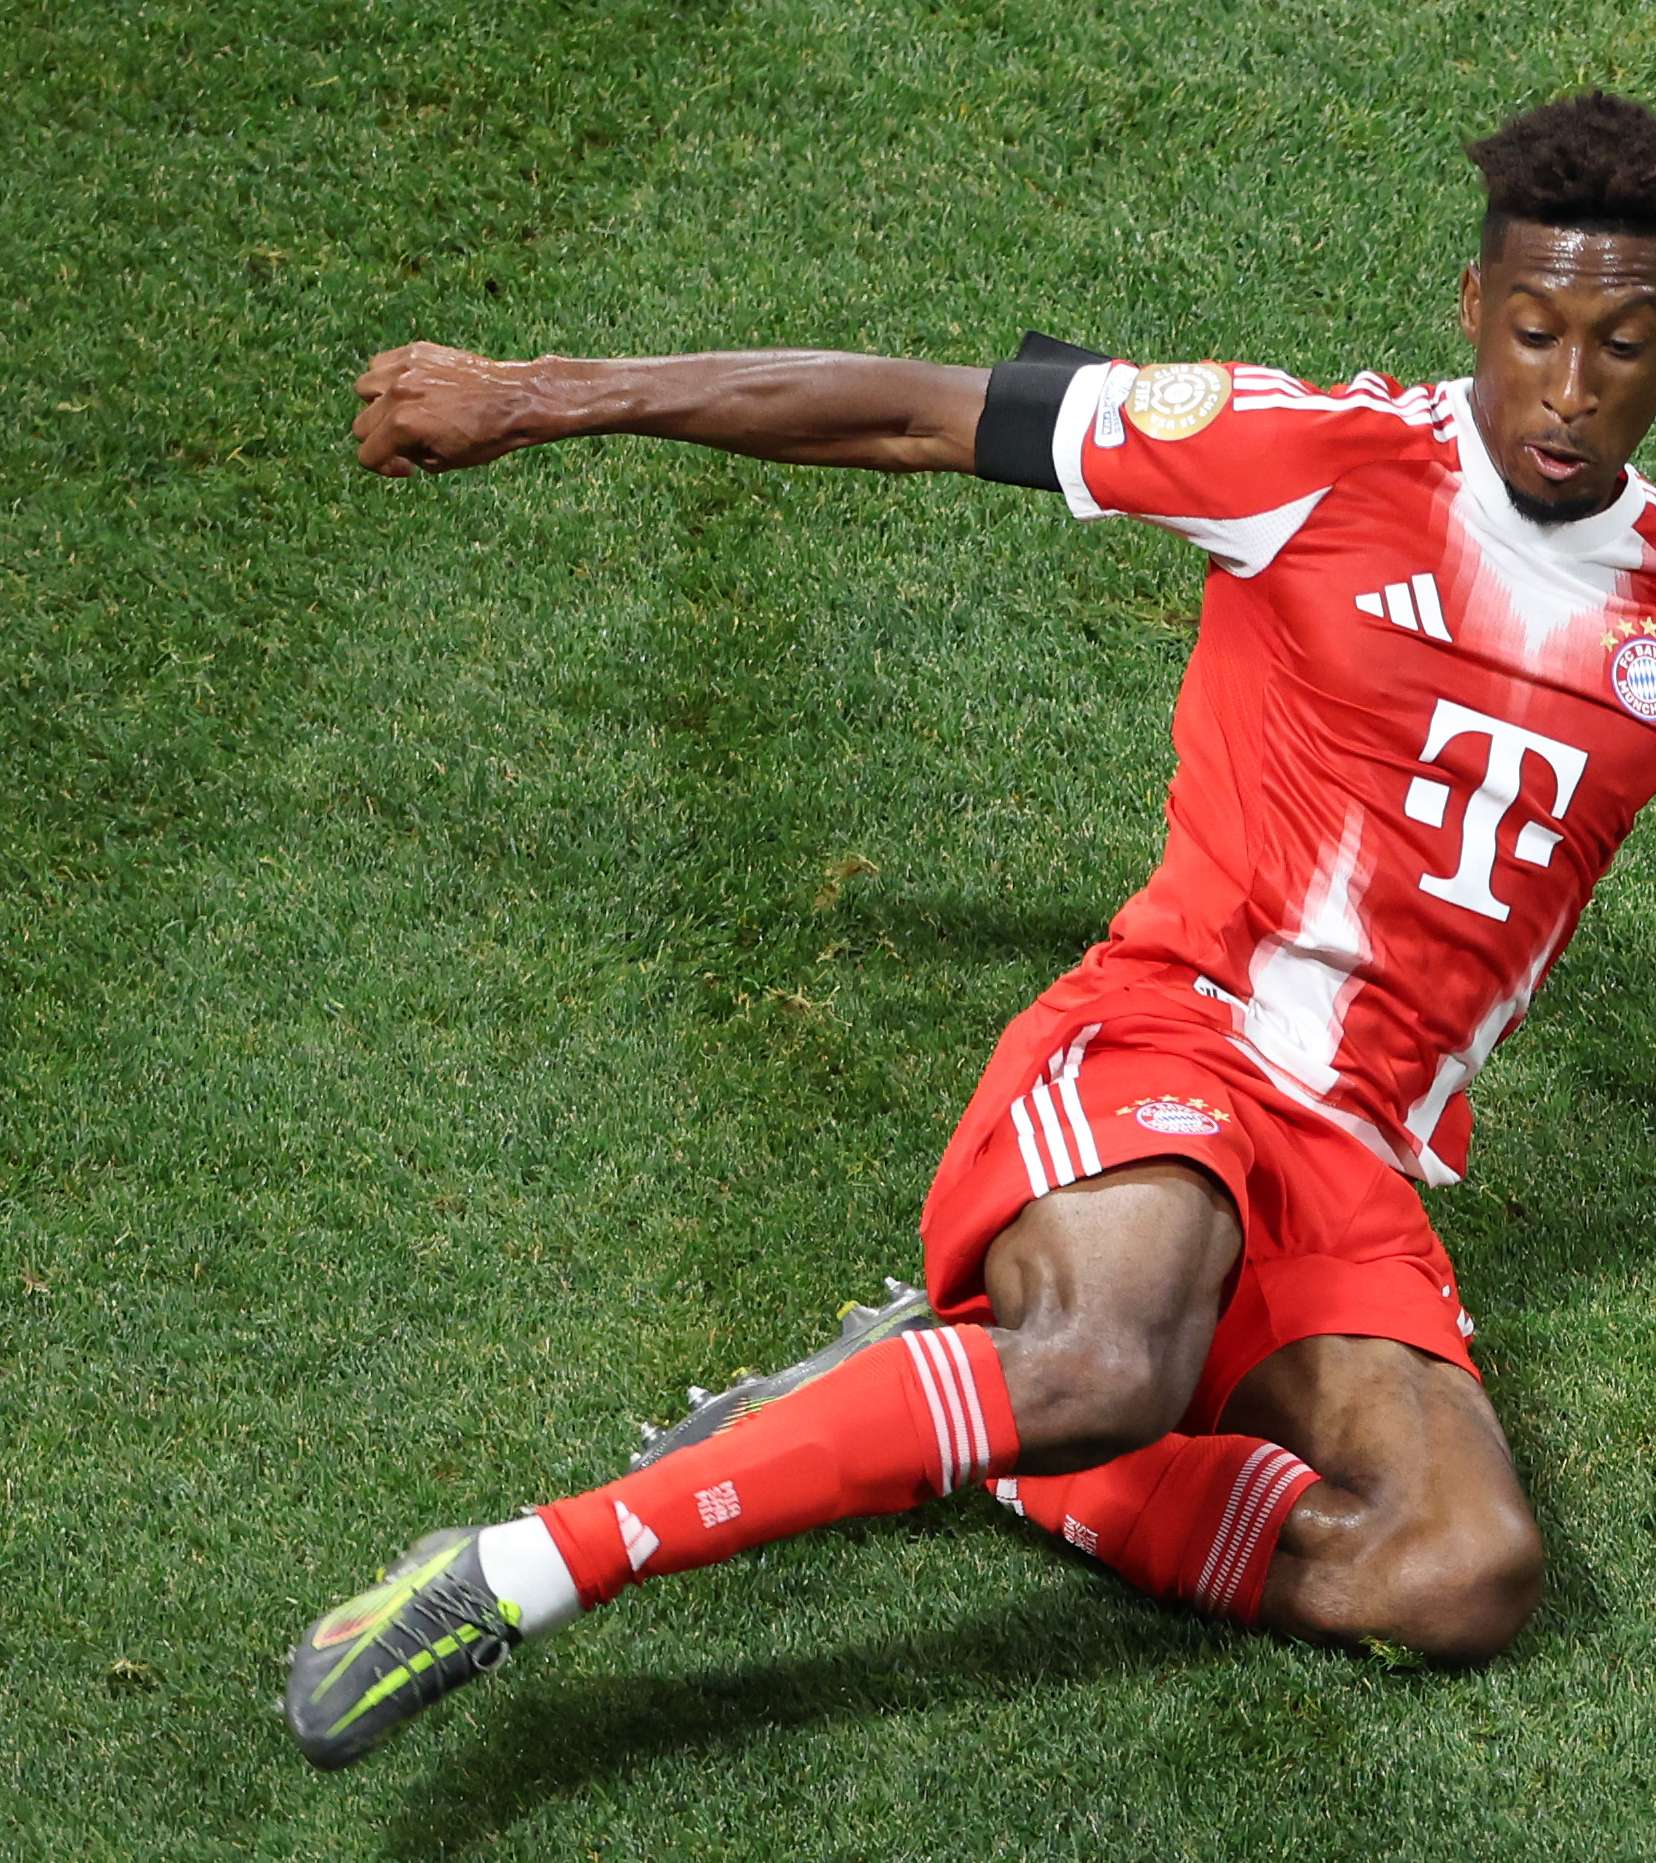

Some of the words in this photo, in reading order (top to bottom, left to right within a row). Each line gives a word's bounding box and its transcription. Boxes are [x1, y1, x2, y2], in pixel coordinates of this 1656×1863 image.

[1154, 364, 1189, 380] CLUB
[1134, 380, 1152, 412] FIFA
[1619, 650, 1635, 669] FC
